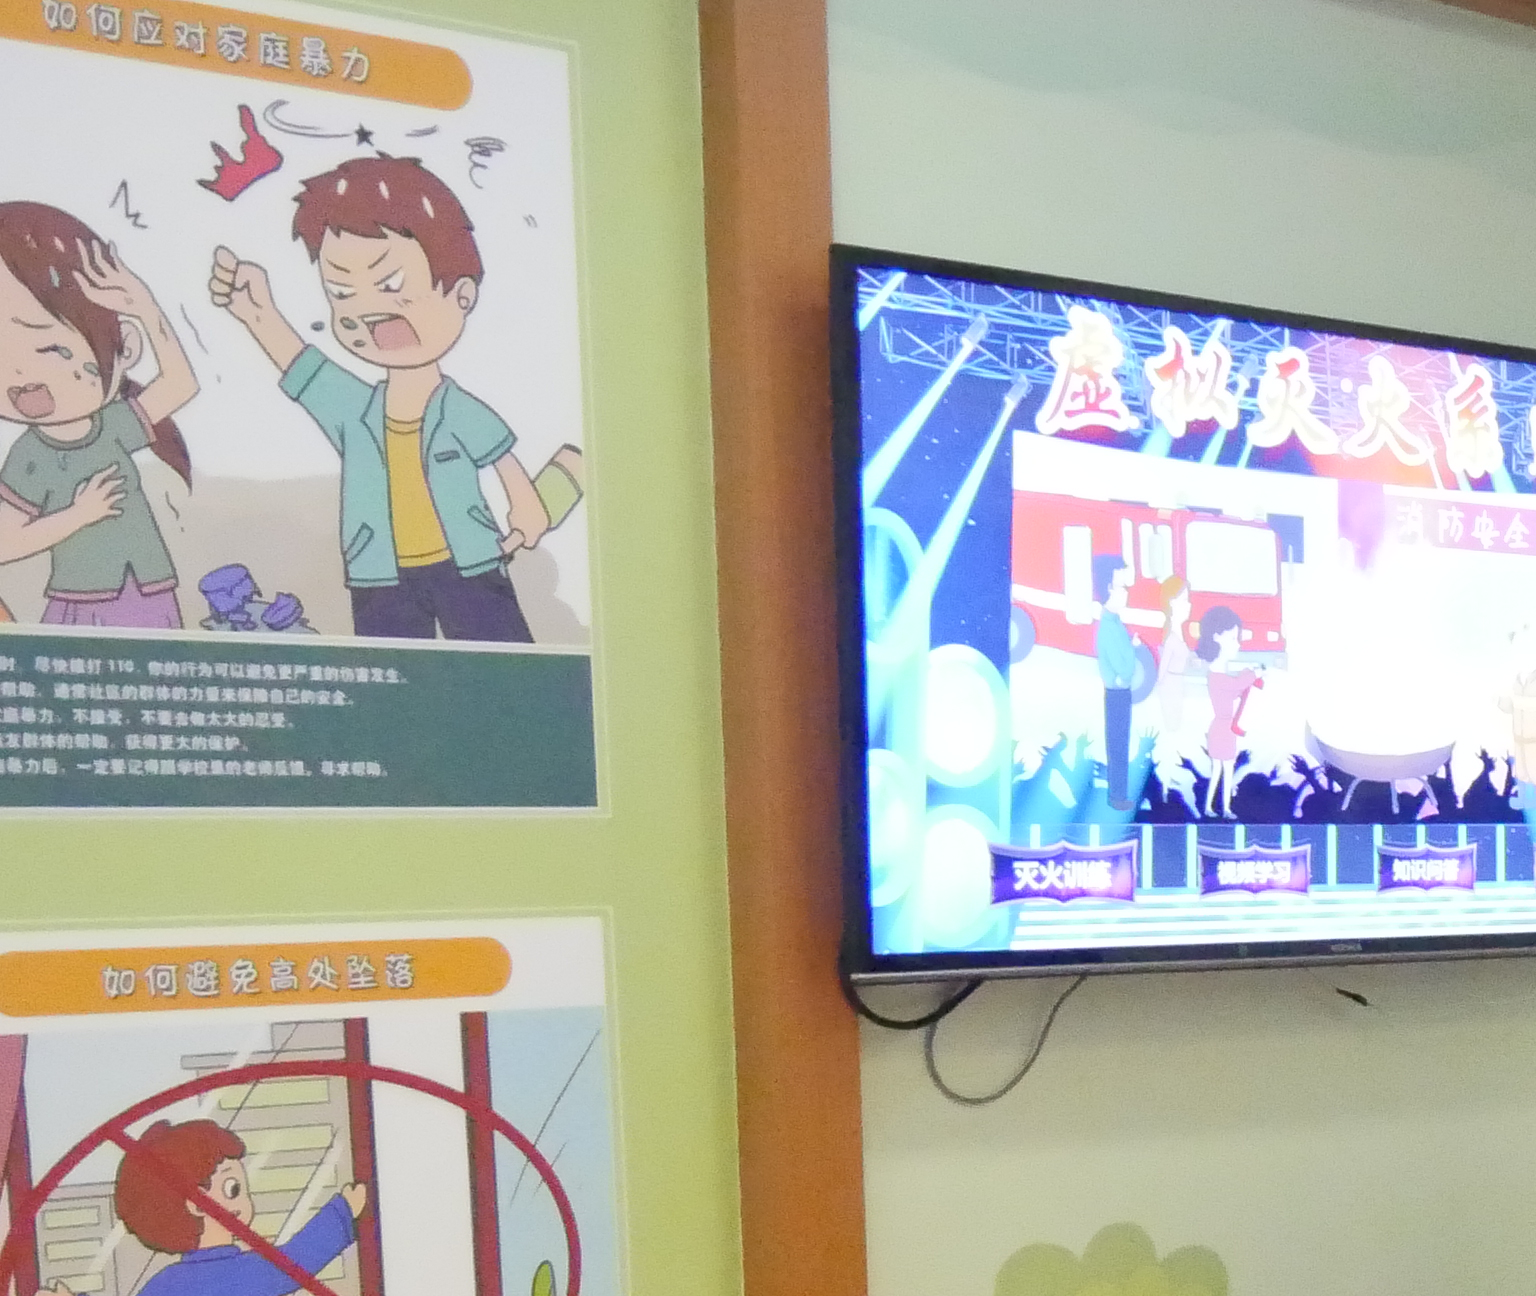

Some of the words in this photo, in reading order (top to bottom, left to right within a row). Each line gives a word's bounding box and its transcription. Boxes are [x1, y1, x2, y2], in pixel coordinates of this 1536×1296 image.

[42, 0, 371, 82] 如何应对家庭暴力
[1012, 860, 1112, 891] 灭火训练
[1216, 860, 1292, 886] 视频学习
[1391, 859, 1460, 884] 知识问答
[101, 953, 414, 998] 如何避免高处坠落
